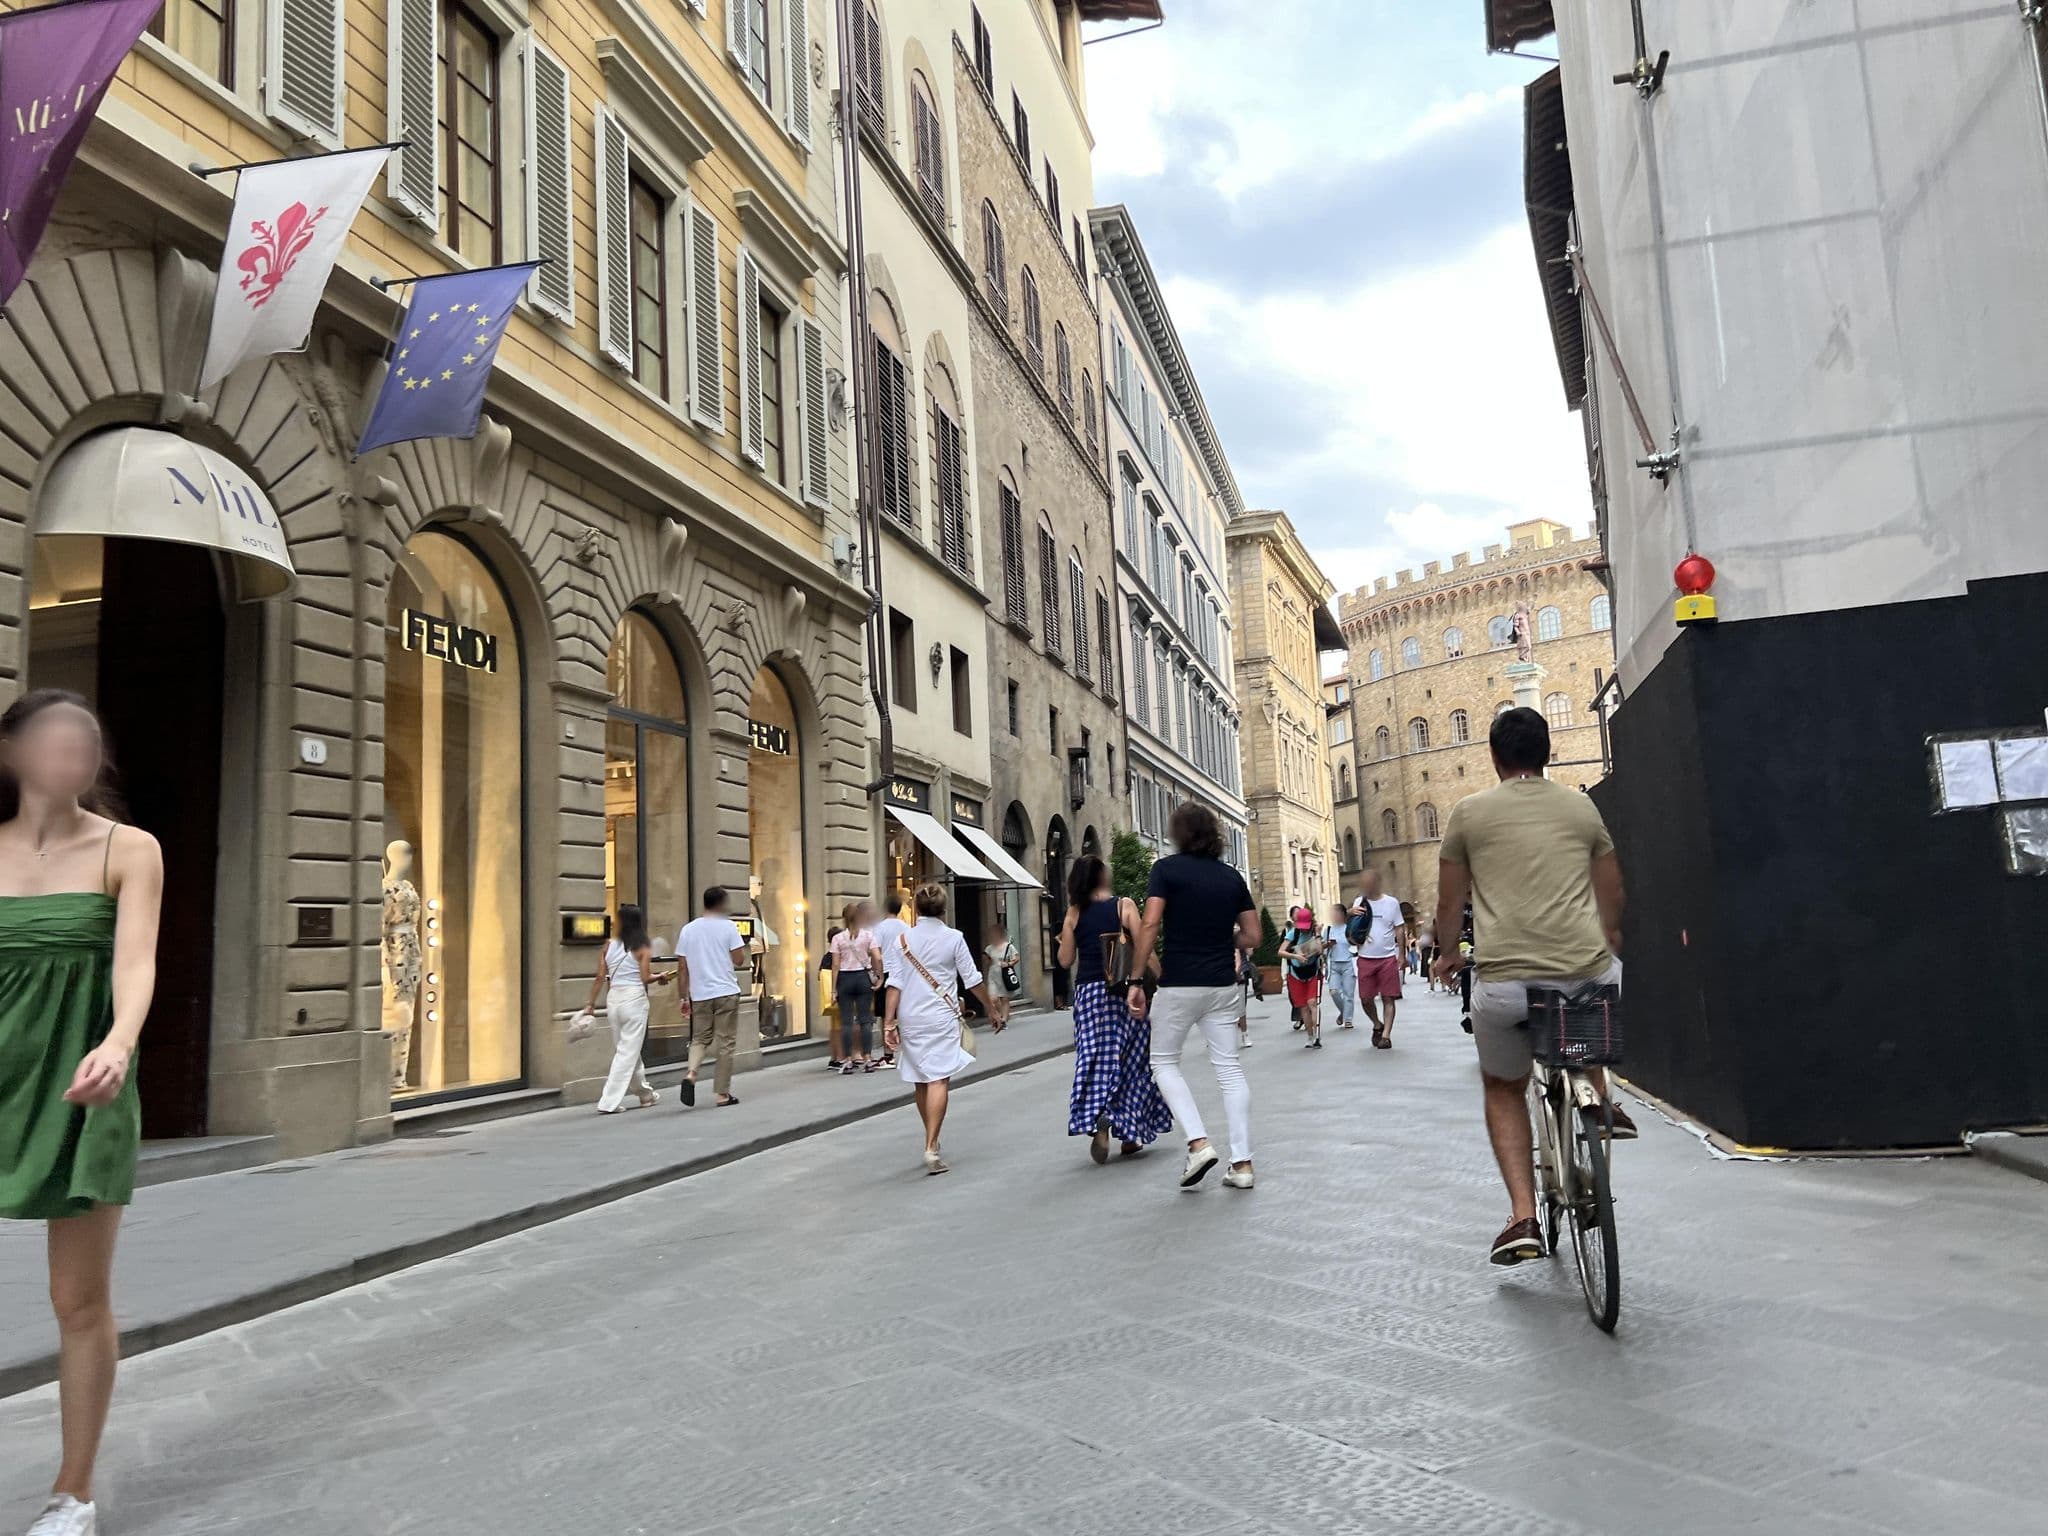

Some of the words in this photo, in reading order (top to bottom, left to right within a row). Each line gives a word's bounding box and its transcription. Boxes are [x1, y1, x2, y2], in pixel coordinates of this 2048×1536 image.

[241, 536, 276, 554] HOTEL
[402, 608, 497, 674] FENDI
[747, 719, 790, 756] FENDI
